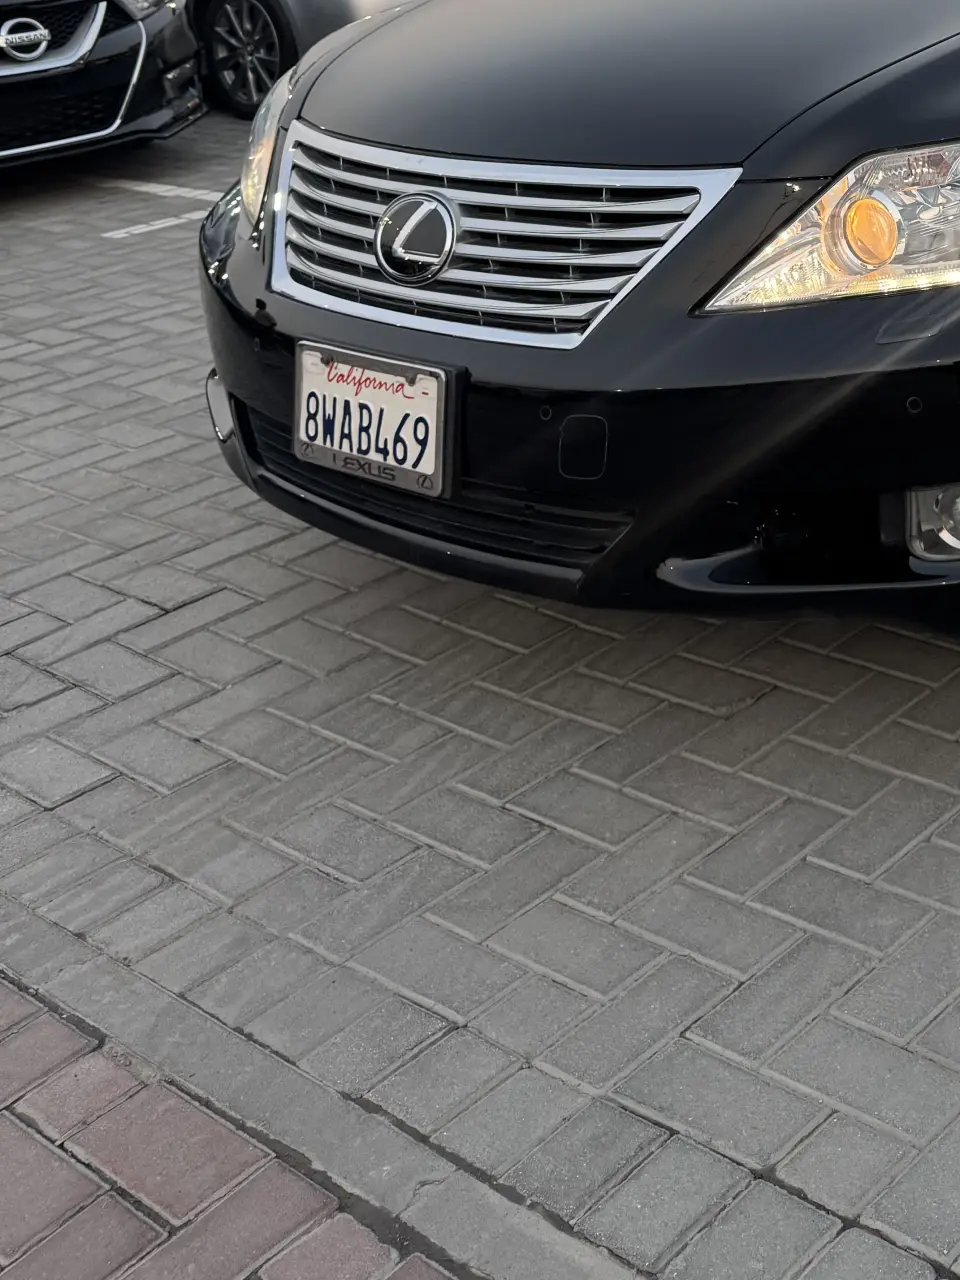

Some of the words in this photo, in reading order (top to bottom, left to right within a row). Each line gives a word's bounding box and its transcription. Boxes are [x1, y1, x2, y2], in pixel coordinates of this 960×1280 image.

[5, 31, 50, 45] NISSAN
[327, 362, 414, 399] California
[304, 391, 430, 470] 8WAB469
